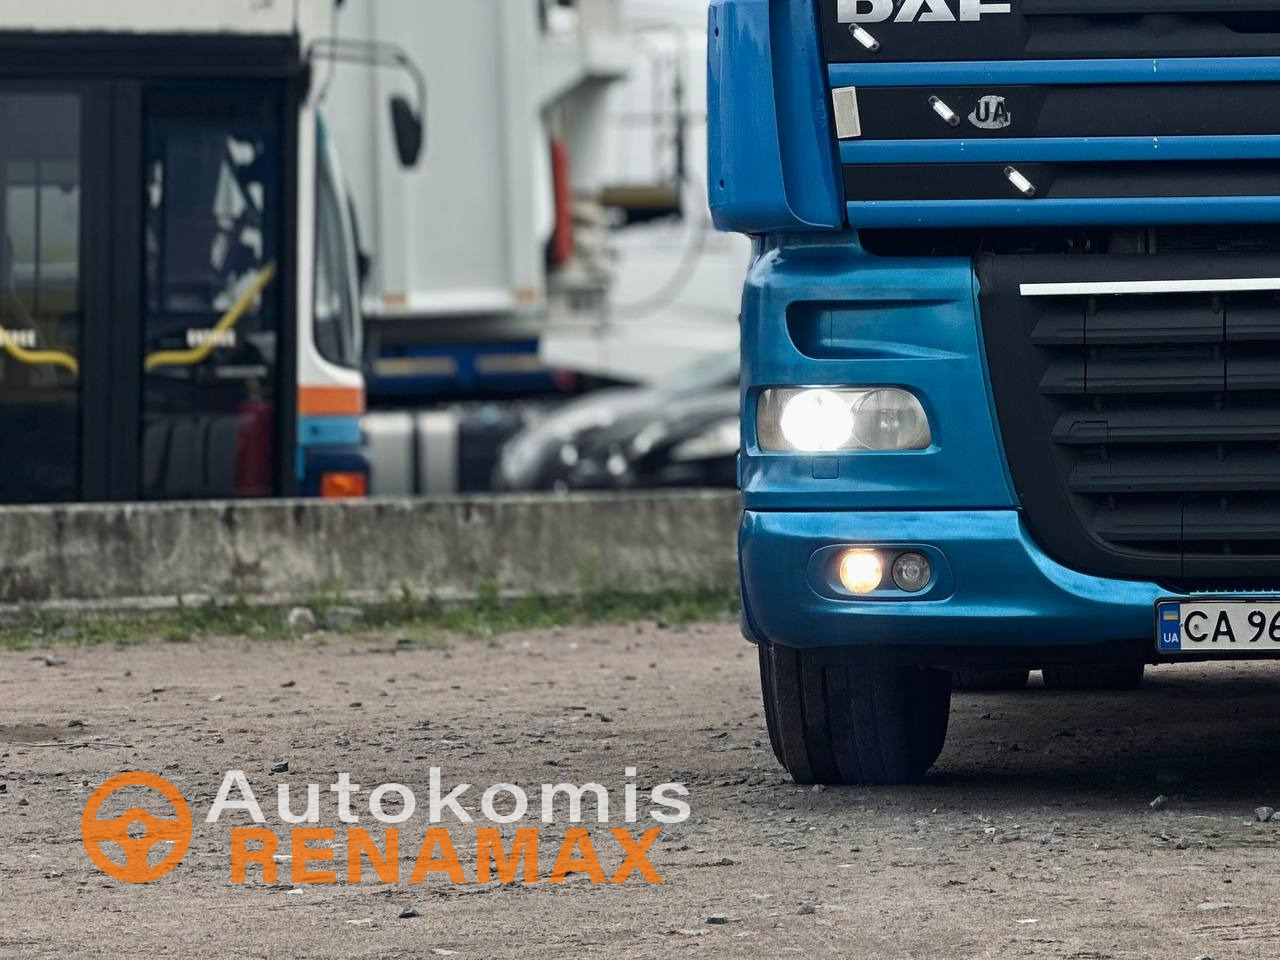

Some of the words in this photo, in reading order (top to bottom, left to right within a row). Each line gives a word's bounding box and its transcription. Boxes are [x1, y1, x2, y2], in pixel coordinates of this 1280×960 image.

[975, 101, 1008, 122] UA
[1184, 610, 1236, 642] CA
[1163, 632, 1179, 643] UA
